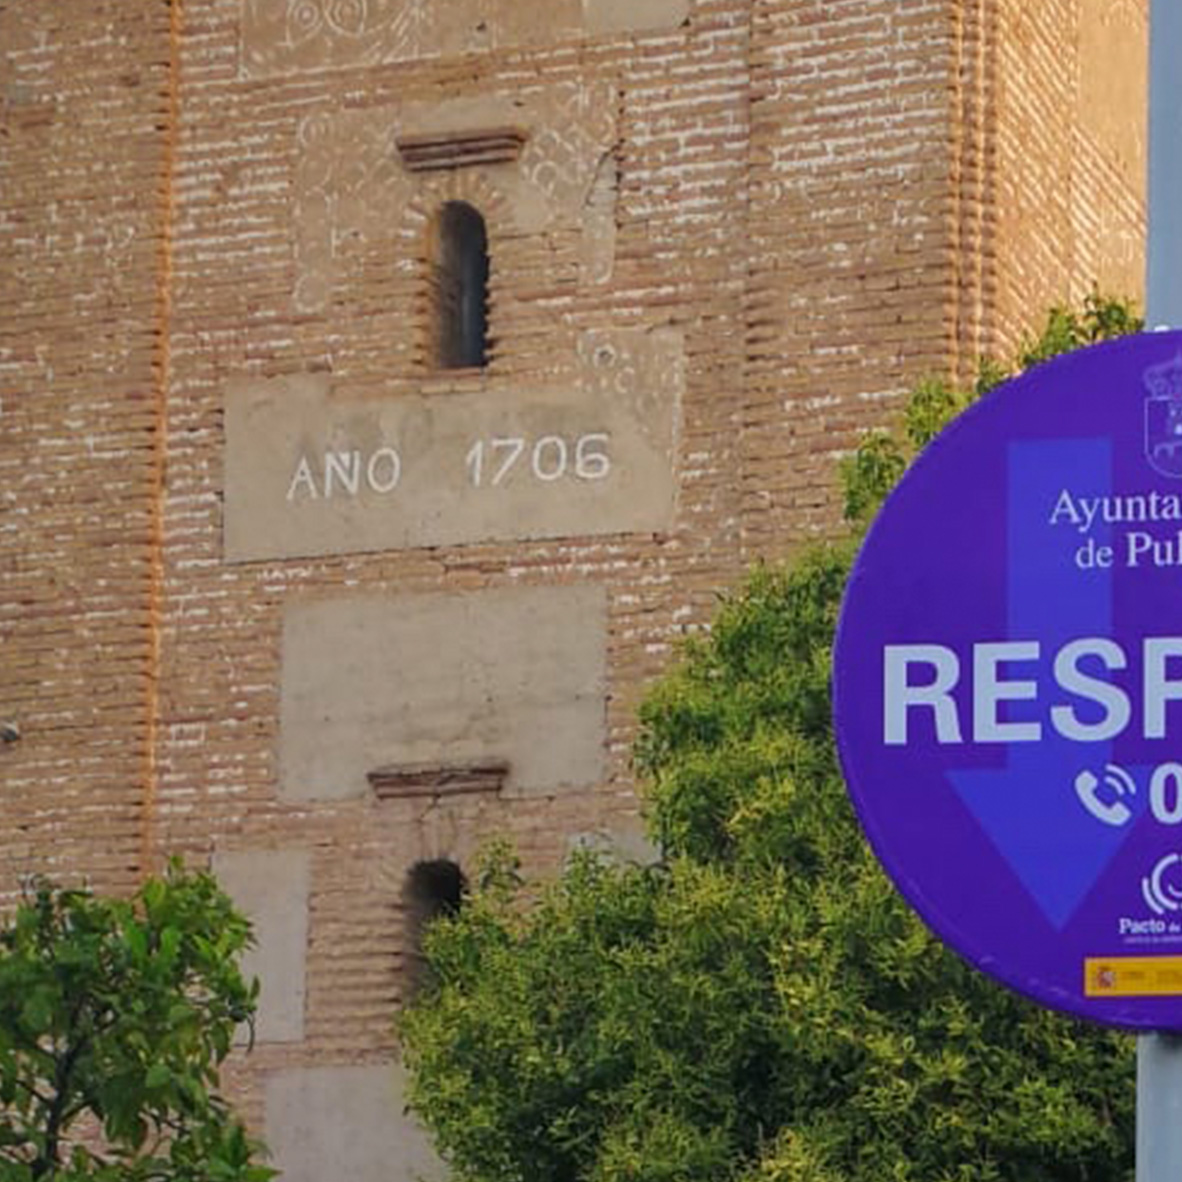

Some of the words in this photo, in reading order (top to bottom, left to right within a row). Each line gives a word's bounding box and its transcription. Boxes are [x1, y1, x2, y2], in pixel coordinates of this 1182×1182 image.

[465, 433, 612, 488] 1706
[1075, 538, 1114, 568] de
[1119, 917, 1167, 934] Pacto
